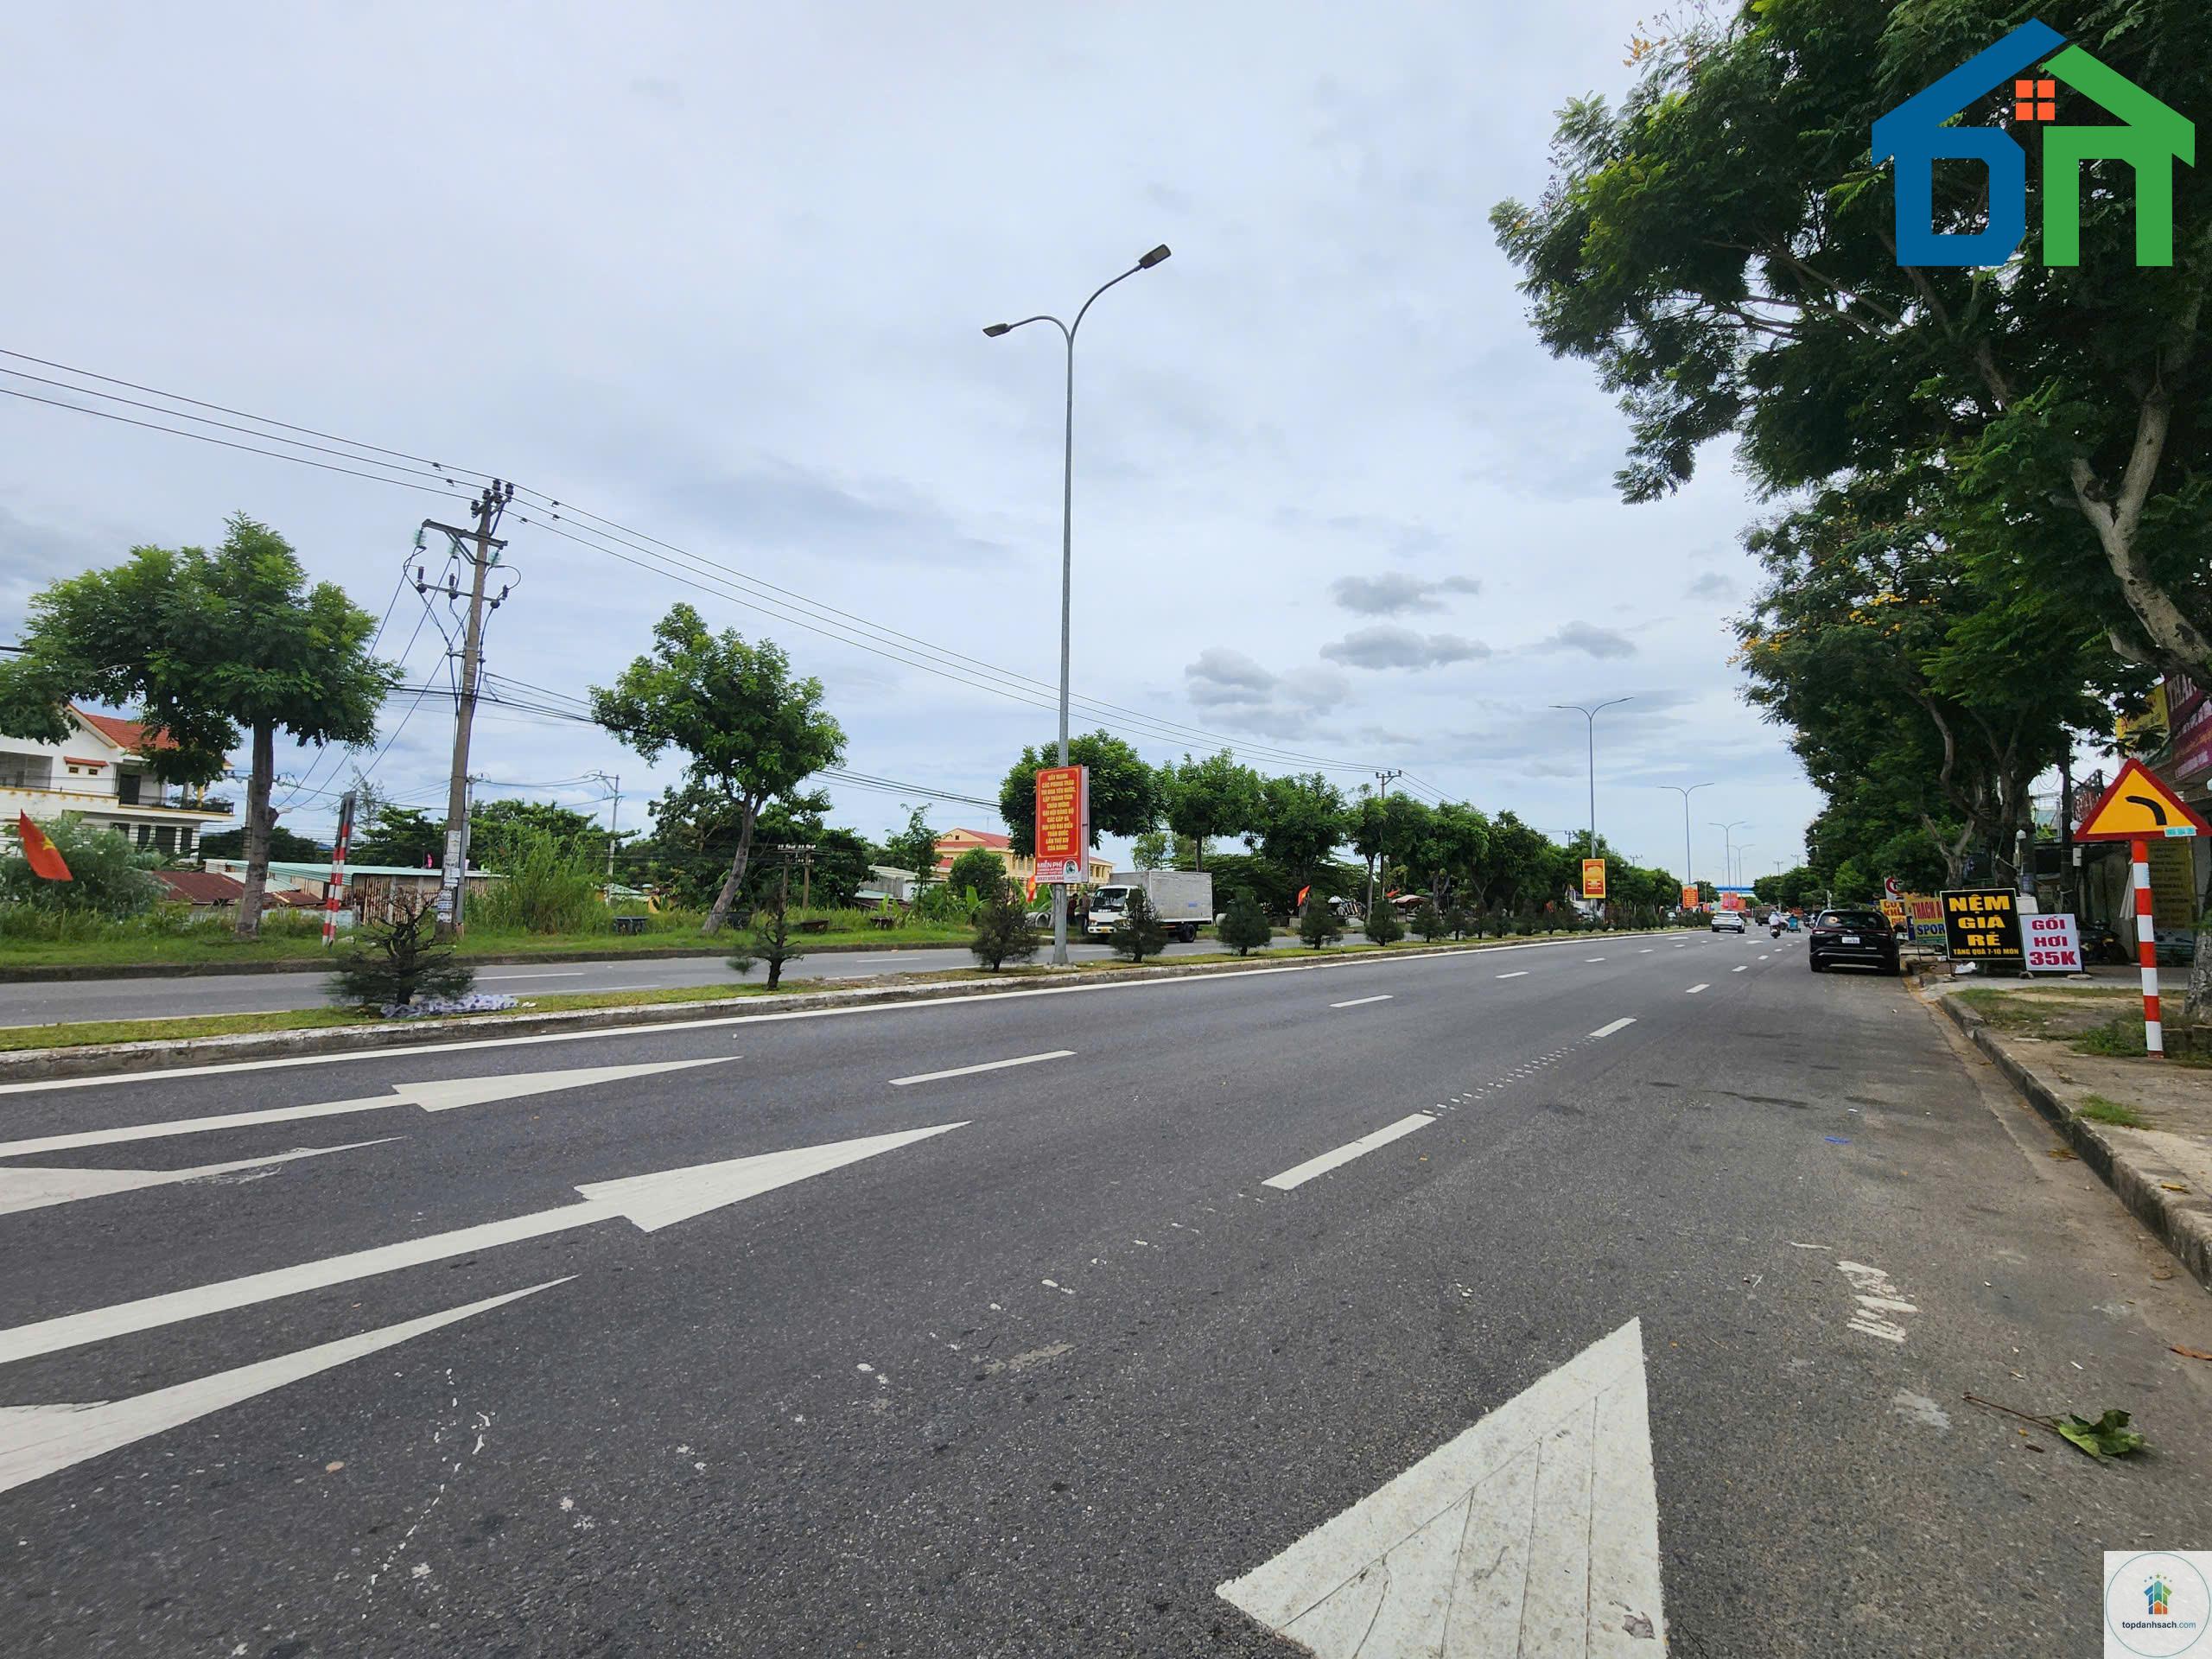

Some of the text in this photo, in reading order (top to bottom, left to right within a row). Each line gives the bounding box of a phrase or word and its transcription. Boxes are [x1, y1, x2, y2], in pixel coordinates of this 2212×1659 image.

[1948, 894, 2011, 914] NỆM
[1958, 914, 2005, 929] GIÁ
[2031, 915, 2066, 931] GỐI
[2033, 935, 2068, 947] HƠI
[2029, 951, 2077, 966] 35K
